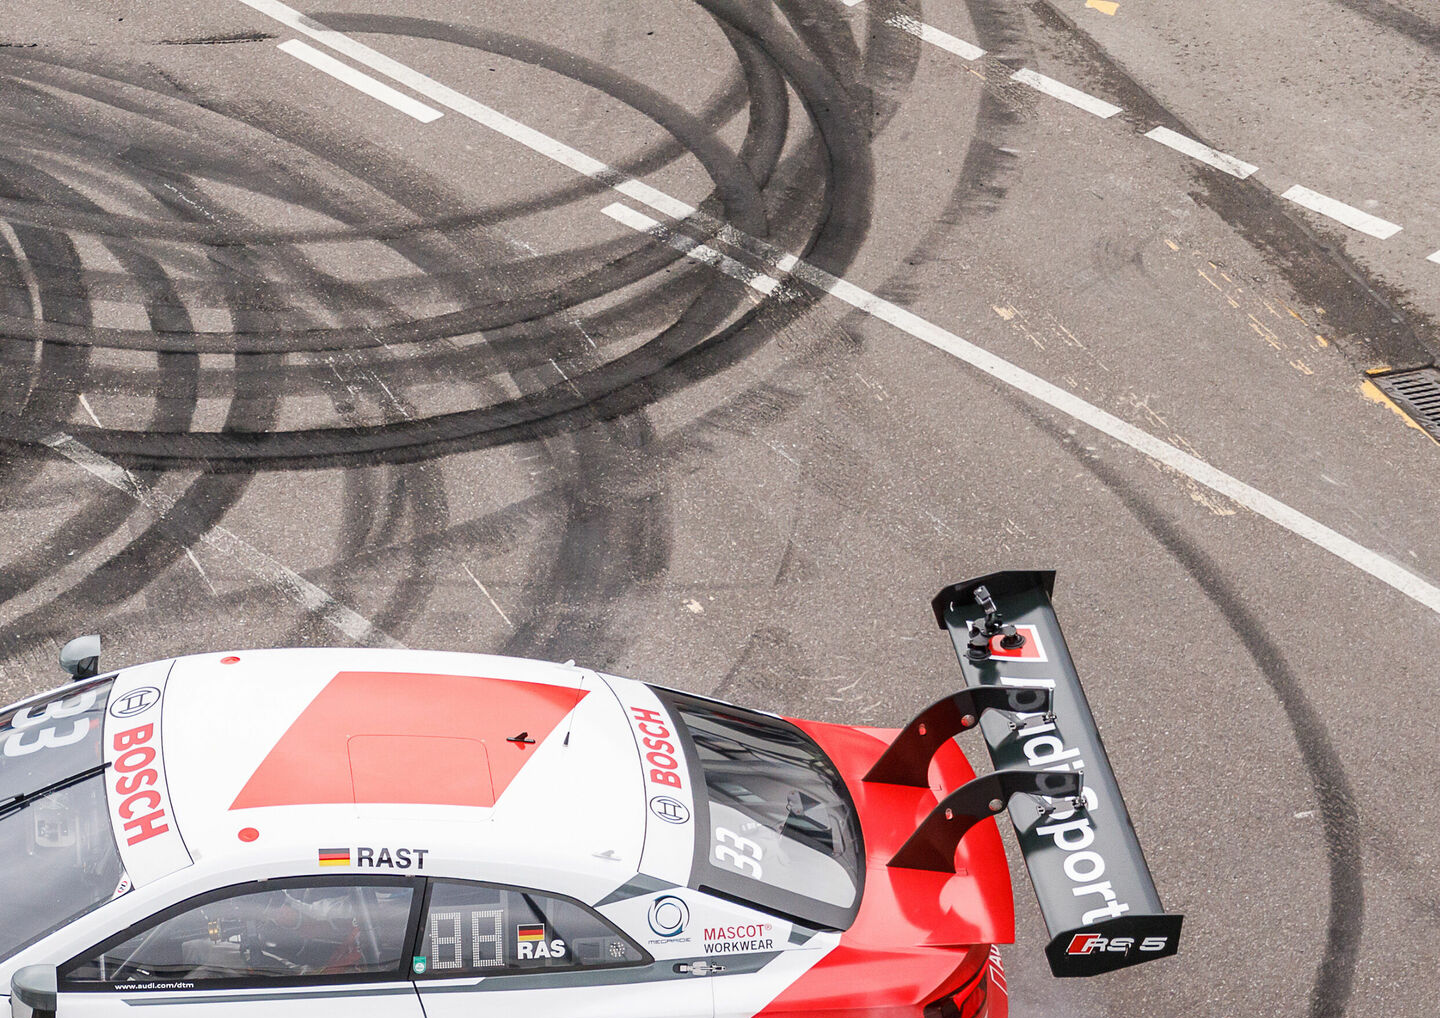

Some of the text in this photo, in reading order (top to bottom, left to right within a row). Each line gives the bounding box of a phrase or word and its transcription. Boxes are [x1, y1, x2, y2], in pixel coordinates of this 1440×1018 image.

[3, 690, 97, 757] 33
[630, 706, 682, 789] BOSCH
[113, 722, 170, 847] BOSCH
[357, 847, 429, 869] RAST
[715, 826, 763, 879] 33
[517, 939, 566, 960] RAS
[703, 939, 773, 954] WORKWEAR
[1081, 937, 1168, 953] RS 5
[114, 982, 194, 990] www.audi.com/dtm
